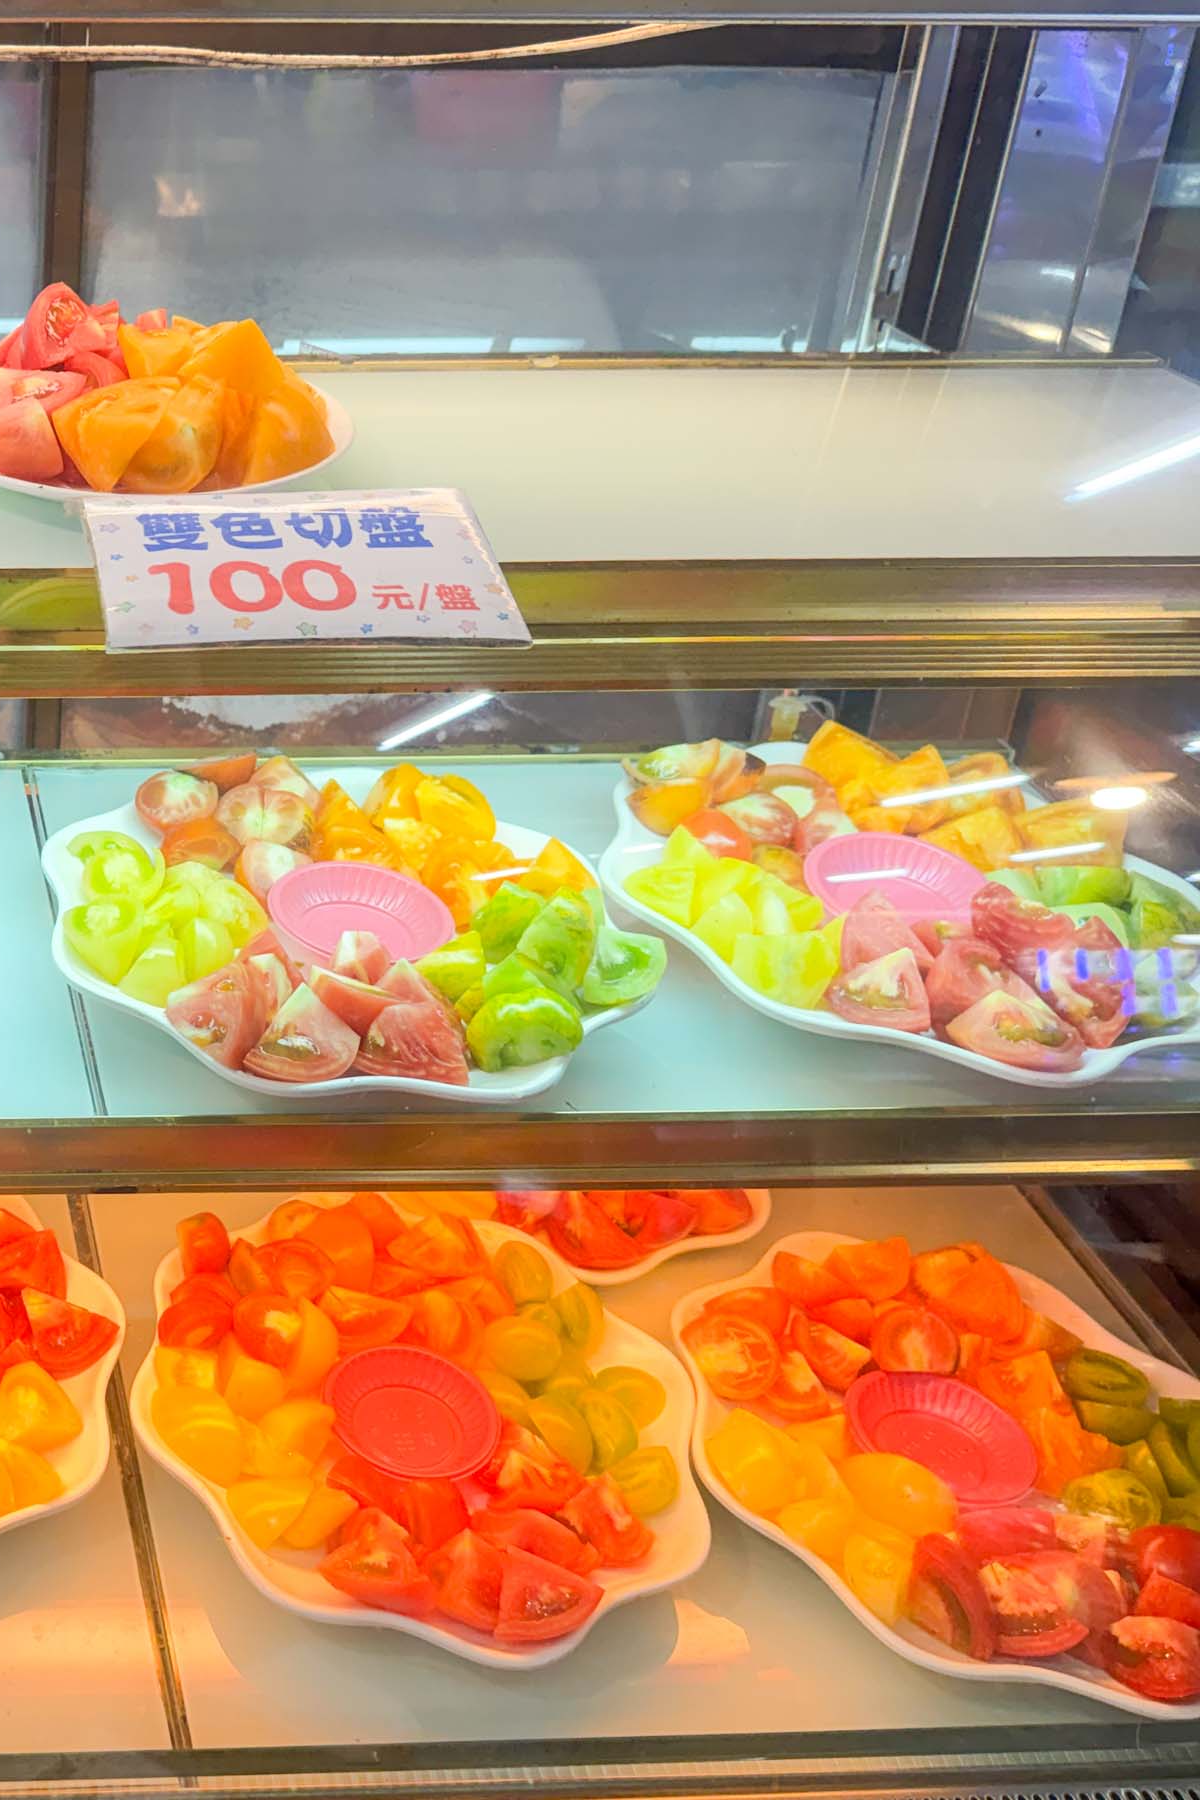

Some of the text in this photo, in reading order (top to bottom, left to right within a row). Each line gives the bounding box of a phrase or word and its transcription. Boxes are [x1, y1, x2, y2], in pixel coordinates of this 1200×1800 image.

[136, 507, 433, 552] 雙色切盤
[148, 559, 481, 614] 100 元/盤
